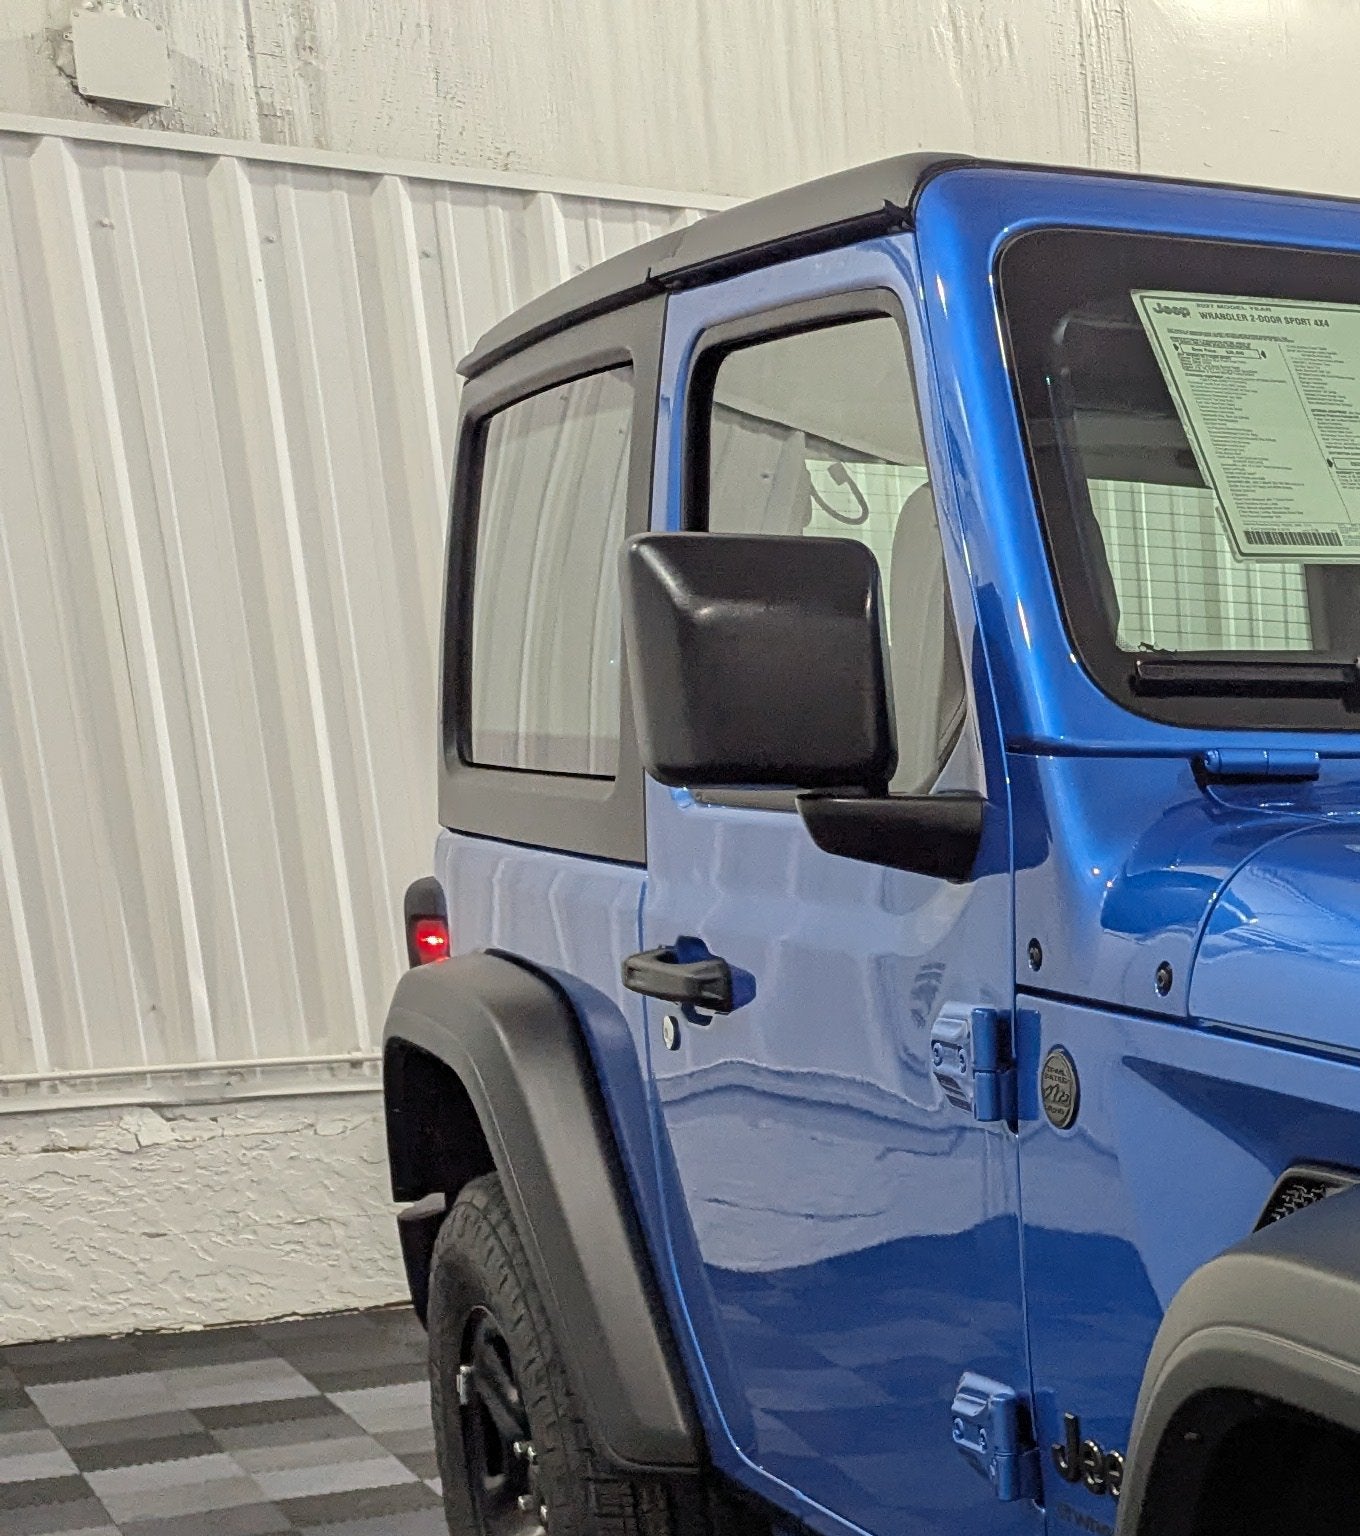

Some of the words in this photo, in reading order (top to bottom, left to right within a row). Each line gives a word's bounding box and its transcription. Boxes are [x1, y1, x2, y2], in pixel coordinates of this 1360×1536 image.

[1152, 302, 1191, 318] Jeep
[1198, 311, 1249, 322] WRANGLER
[1249, 314, 1283, 325] 2-DOOR
[1283, 316, 1312, 327] SPORT
[1313, 318, 1330, 328] 4X4
[1051, 1411, 1124, 1501] Jee
